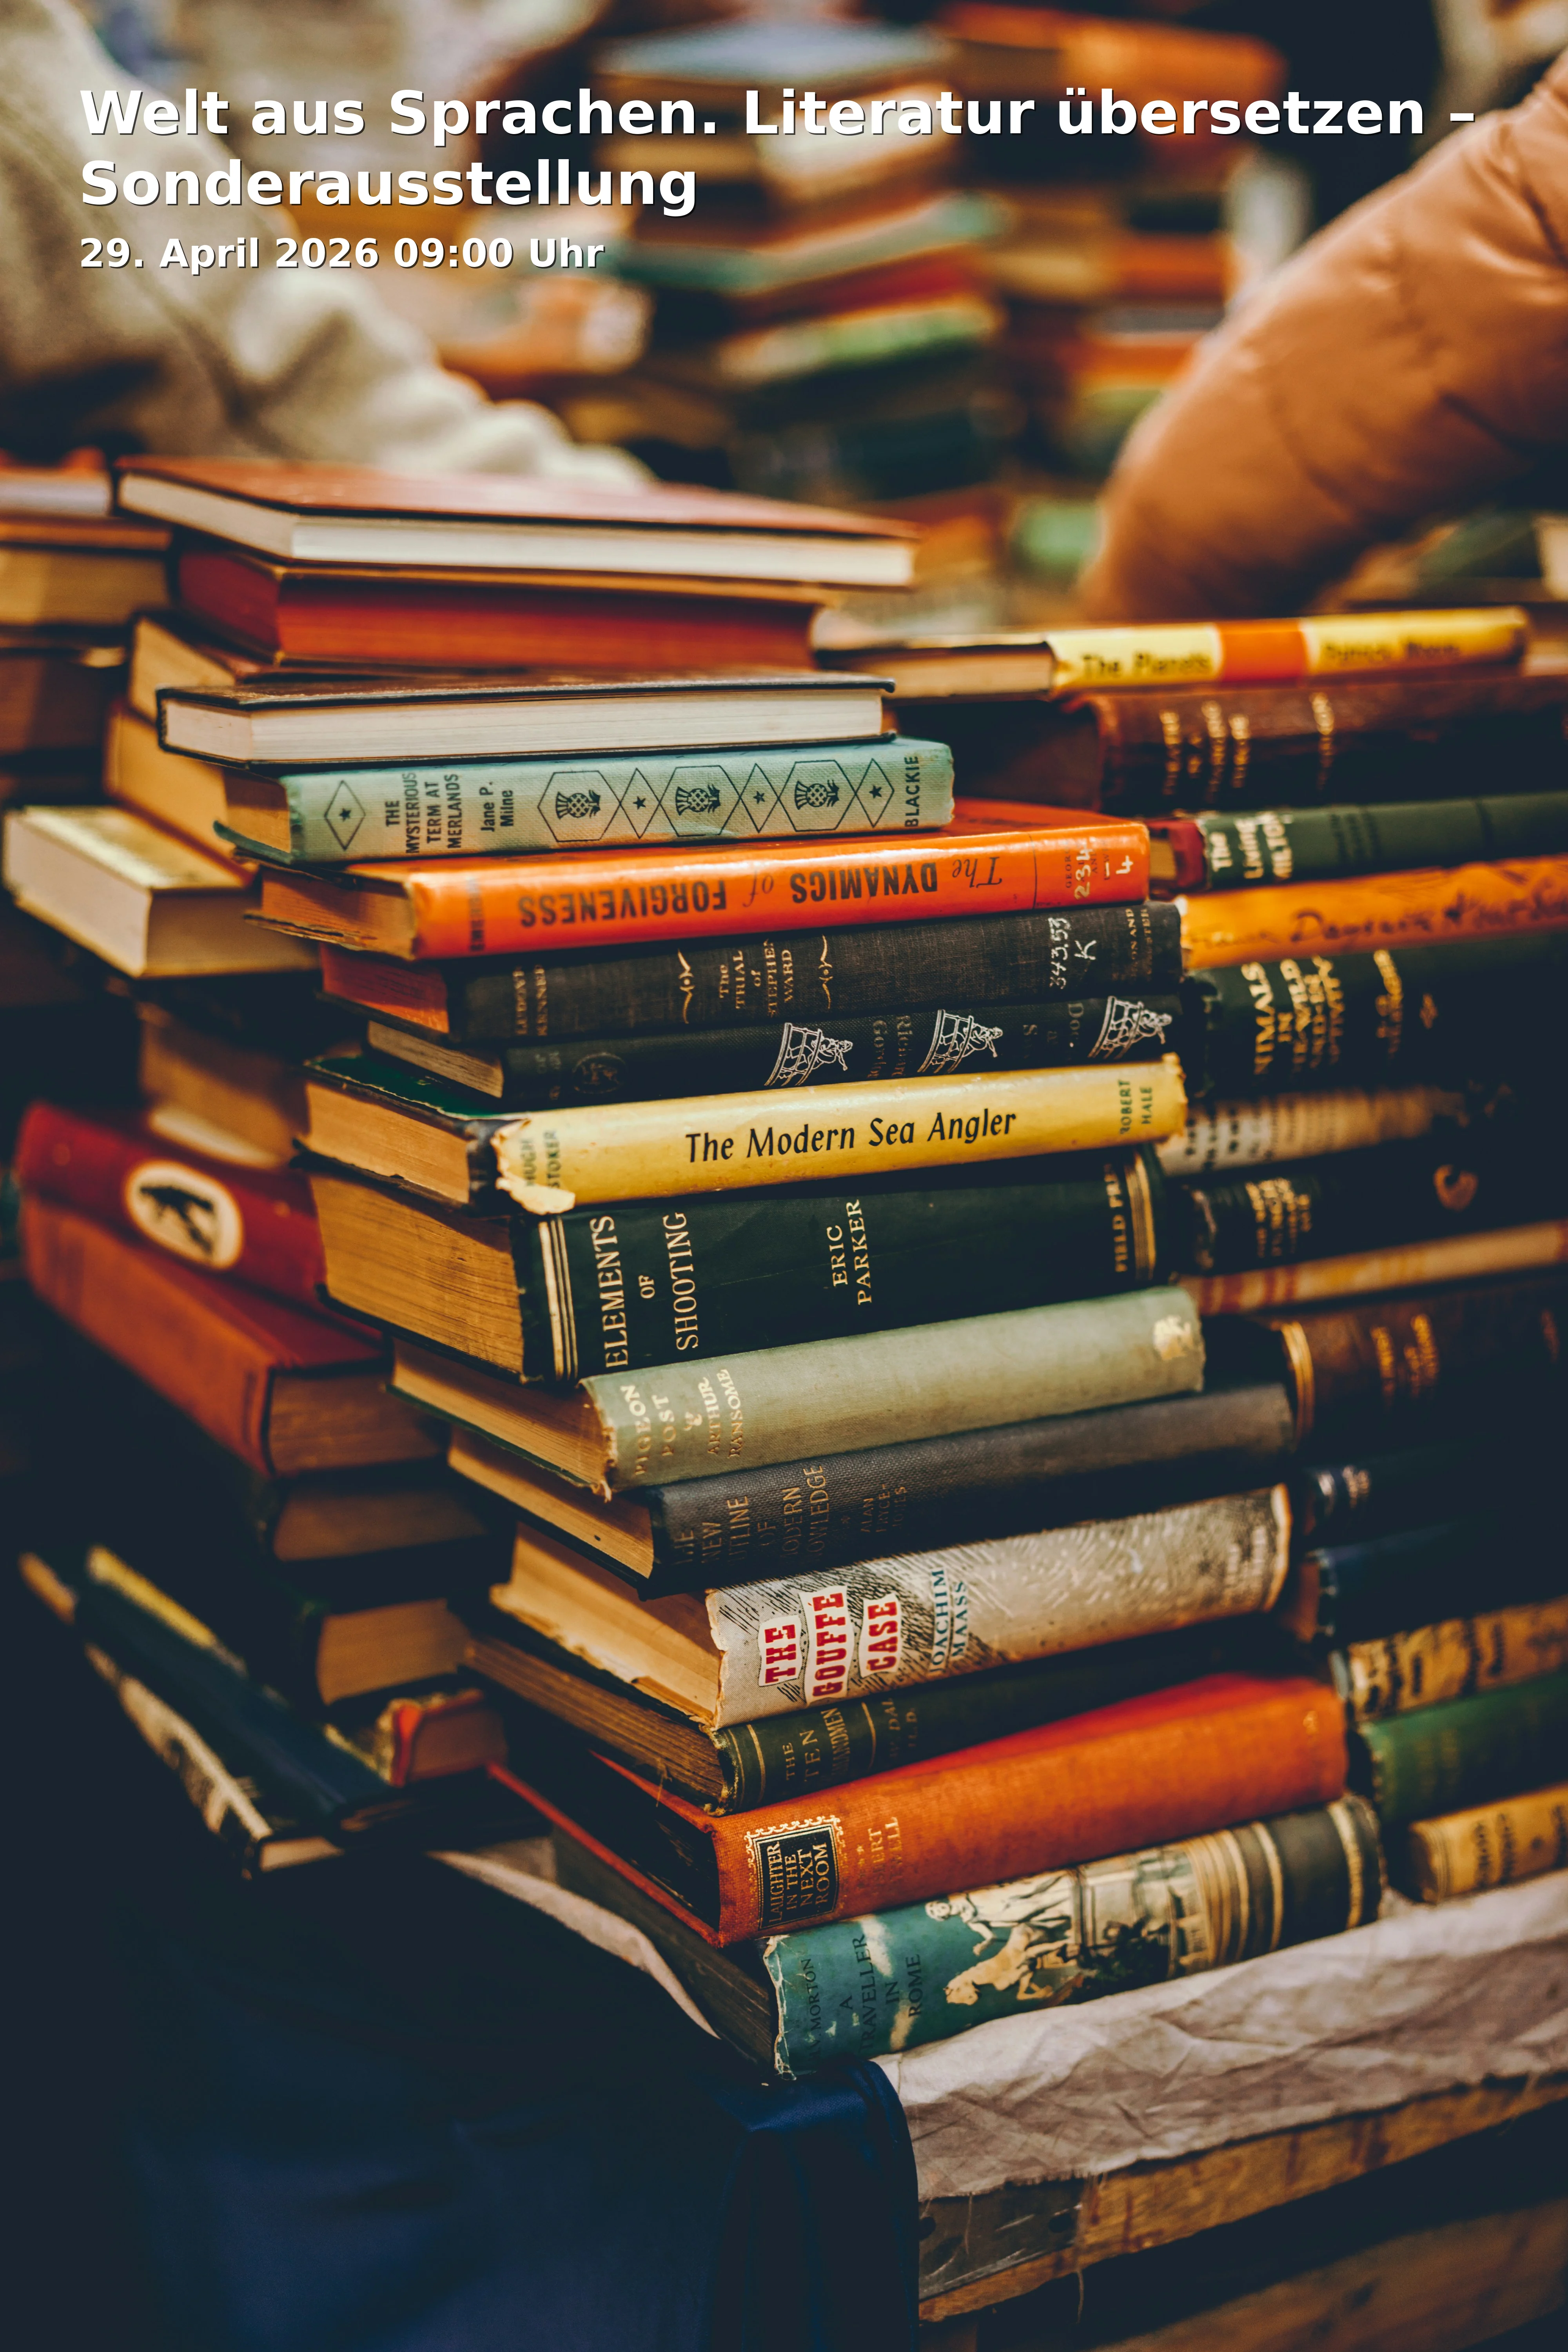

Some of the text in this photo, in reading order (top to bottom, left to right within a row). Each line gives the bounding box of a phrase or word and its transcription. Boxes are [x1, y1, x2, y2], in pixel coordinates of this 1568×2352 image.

[385, 800, 401, 827] THE
[402, 772, 419, 854] MYSTERIOUS
[425, 781, 442, 844] TERM AT
[444, 773, 463, 849] MERLANDS
[479, 781, 495, 832] Jane P.
[499, 789, 514, 827] Milne
[904, 755, 920, 828] BLACKIE
[742, 869, 774, 907] of
[789, 862, 938, 904] DYNAMICS
[952, 857, 1002, 888] The
[1074, 838, 1094, 900] 234
[1115, 855, 1134, 875] 4
[519, 880, 727, 927] FORGIVENESS
[1125, 907, 1138, 938] AND
[732, 949, 746, 1009] TRIAL
[750, 969, 762, 987] of
[780, 949, 794, 1003] WARD
[1047, 916, 1072, 990] 343.53
[1073, 938, 1097, 961] K
[719, 964, 730, 998] The
[1241, 961, 1276, 1075] NIMALS
[686, 1108, 1017, 1163] The Modern Sea Angler
[1118, 1080, 1133, 1134] ROBERT
[1140, 1086, 1153, 1125] HALE
[826, 1224, 849, 1288] ERIC
[845, 1198, 872, 1305] PARKER
[1111, 1214, 1129, 1273] FIELD
[589, 1215, 628, 1368] ELEMENTS
[638, 1274, 655, 1299] OF
[662, 1211, 699, 1351] SHOOTING
[619, 1383, 652, 1476] PIGEON
[651, 1394, 677, 1457] POST
[697, 1376, 721, 1455] ARTHUR
[716, 1368, 743, 1459] RANSOME
[701, 1521, 722, 1564] NEW
[726, 1495, 750, 1564] UTLINE
[781, 1486, 802, 1559] ODERN
[802, 1465, 830, 1562] OWLEDGE
[860, 1497, 875, 1533] ALAN
[867, 1601, 898, 1672] CASE
[929, 1570, 949, 1673] JOACHIM
[951, 1581, 969, 1657] MAASS
[764, 1624, 797, 1684] THE
[782, 1742, 796, 1781] THE
[799, 1728, 822, 1782] TEN
[820, 1707, 851, 1777] MANDMEN
[766, 1841, 785, 1923] LAUGHTER
[784, 1854, 799, 1910] IN THE
[797, 1849, 815, 1907] NEXT
[812, 1842, 830, 1904] ROOM
[800, 1958, 822, 2031] MORTON
[838, 1994, 853, 2011] A
[851, 1933, 877, 2053] TRAVELLER
[884, 1981, 900, 2005] IN
[905, 1954, 924, 2017] ROME
